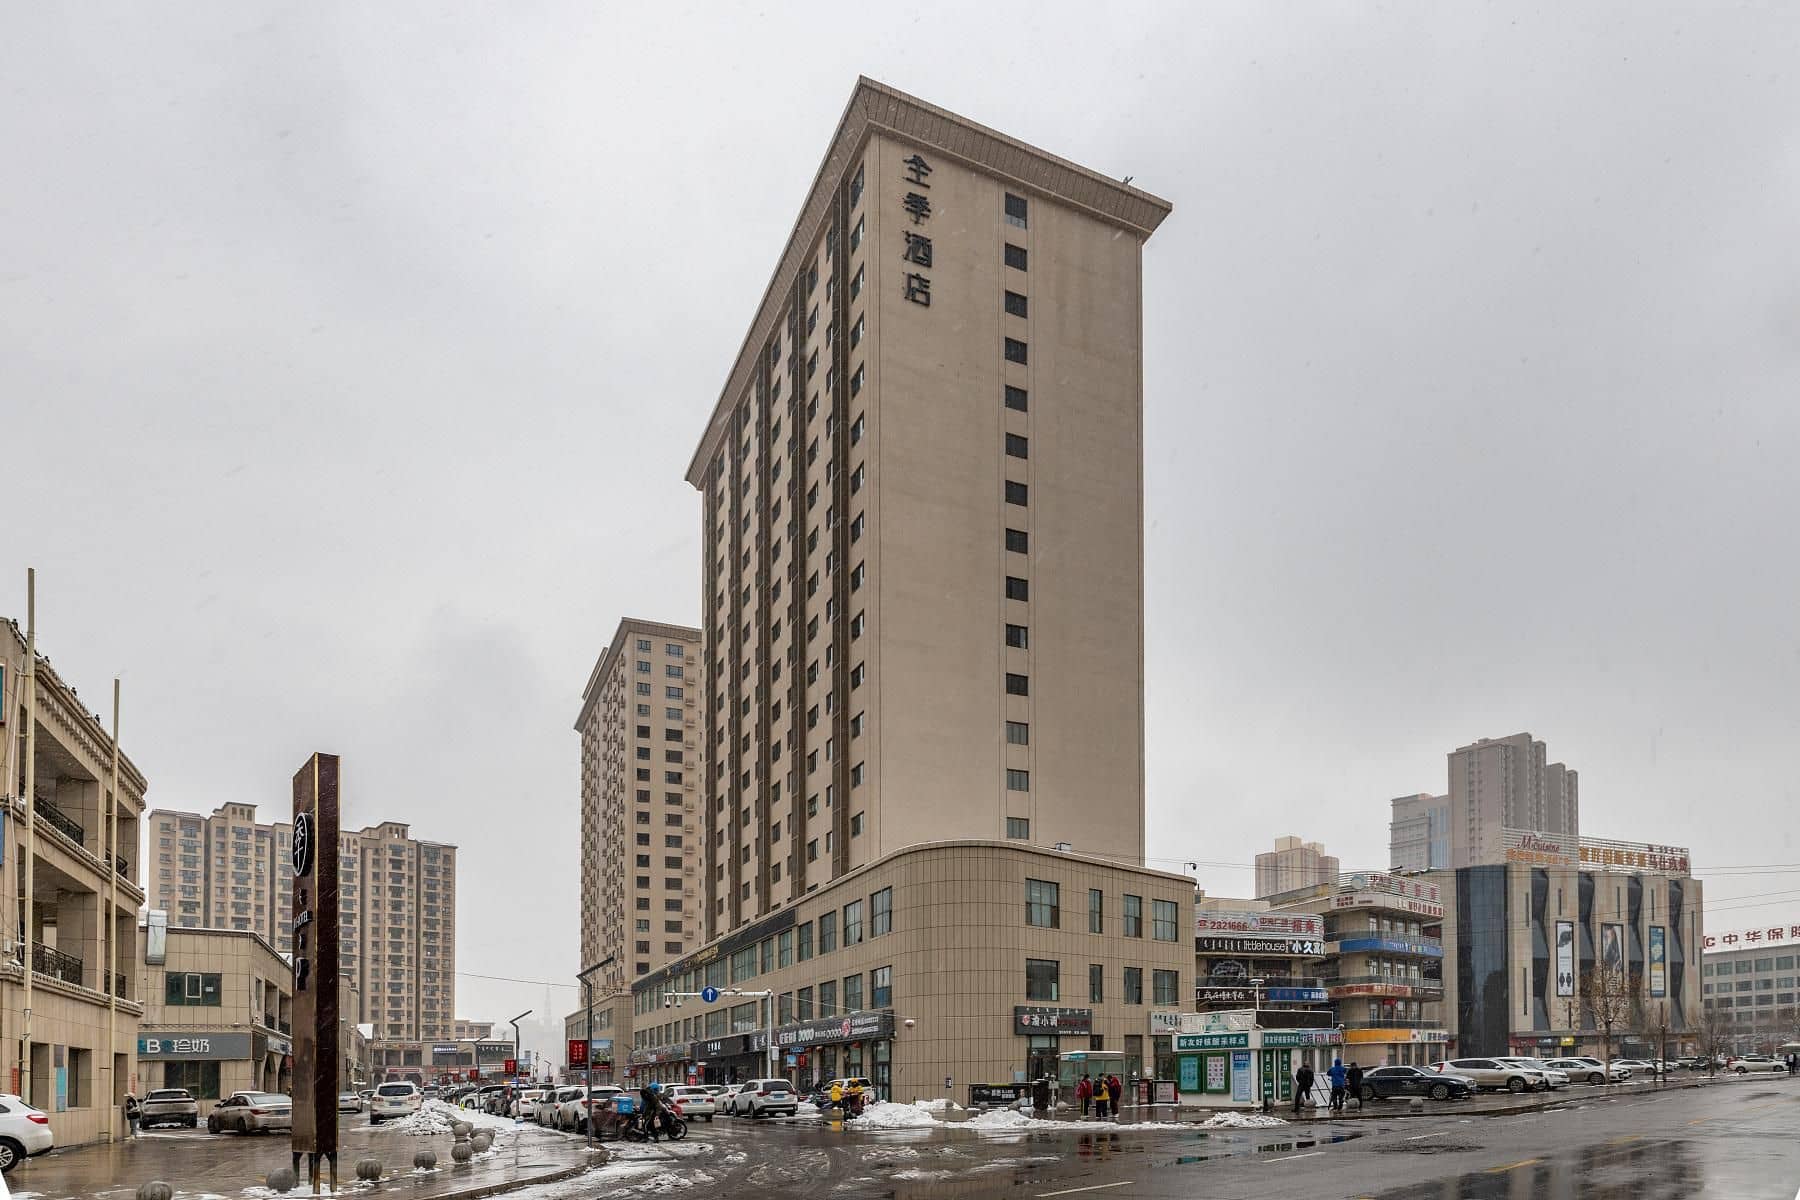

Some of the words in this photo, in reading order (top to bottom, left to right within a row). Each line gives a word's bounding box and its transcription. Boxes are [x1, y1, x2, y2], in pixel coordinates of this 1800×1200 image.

[903, 153, 933, 308] 全季酒店
[1179, 1036, 1246, 1047] 新友好核酸采样点
